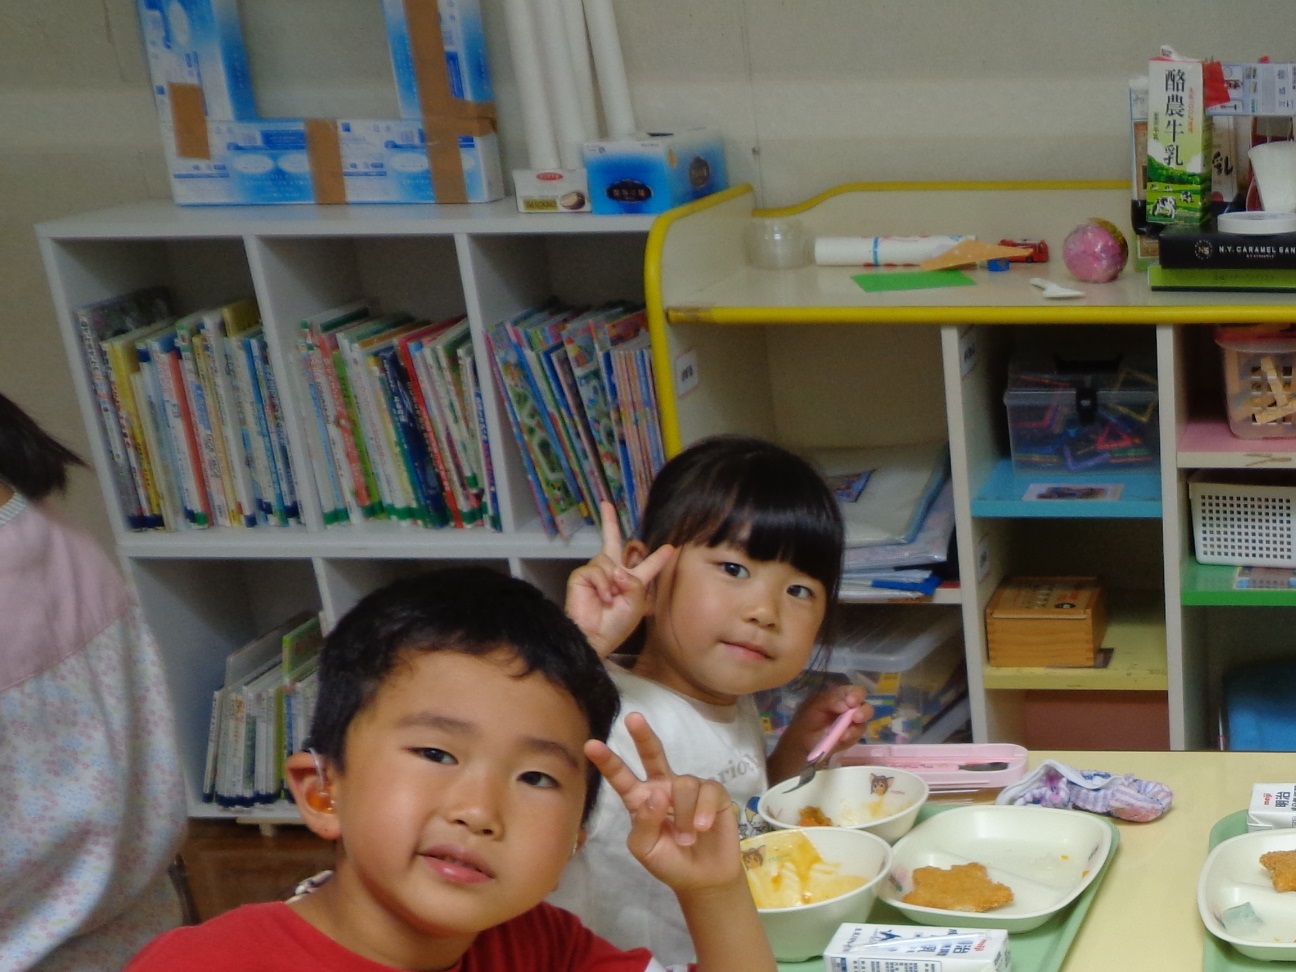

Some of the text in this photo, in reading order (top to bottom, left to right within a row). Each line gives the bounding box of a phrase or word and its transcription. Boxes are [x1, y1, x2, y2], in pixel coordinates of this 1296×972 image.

[1164, 69, 1186, 166] 酪農牛乳
[1237, 245, 1276, 254] CARAMEL
[1275, 791, 1291, 807] 明治
